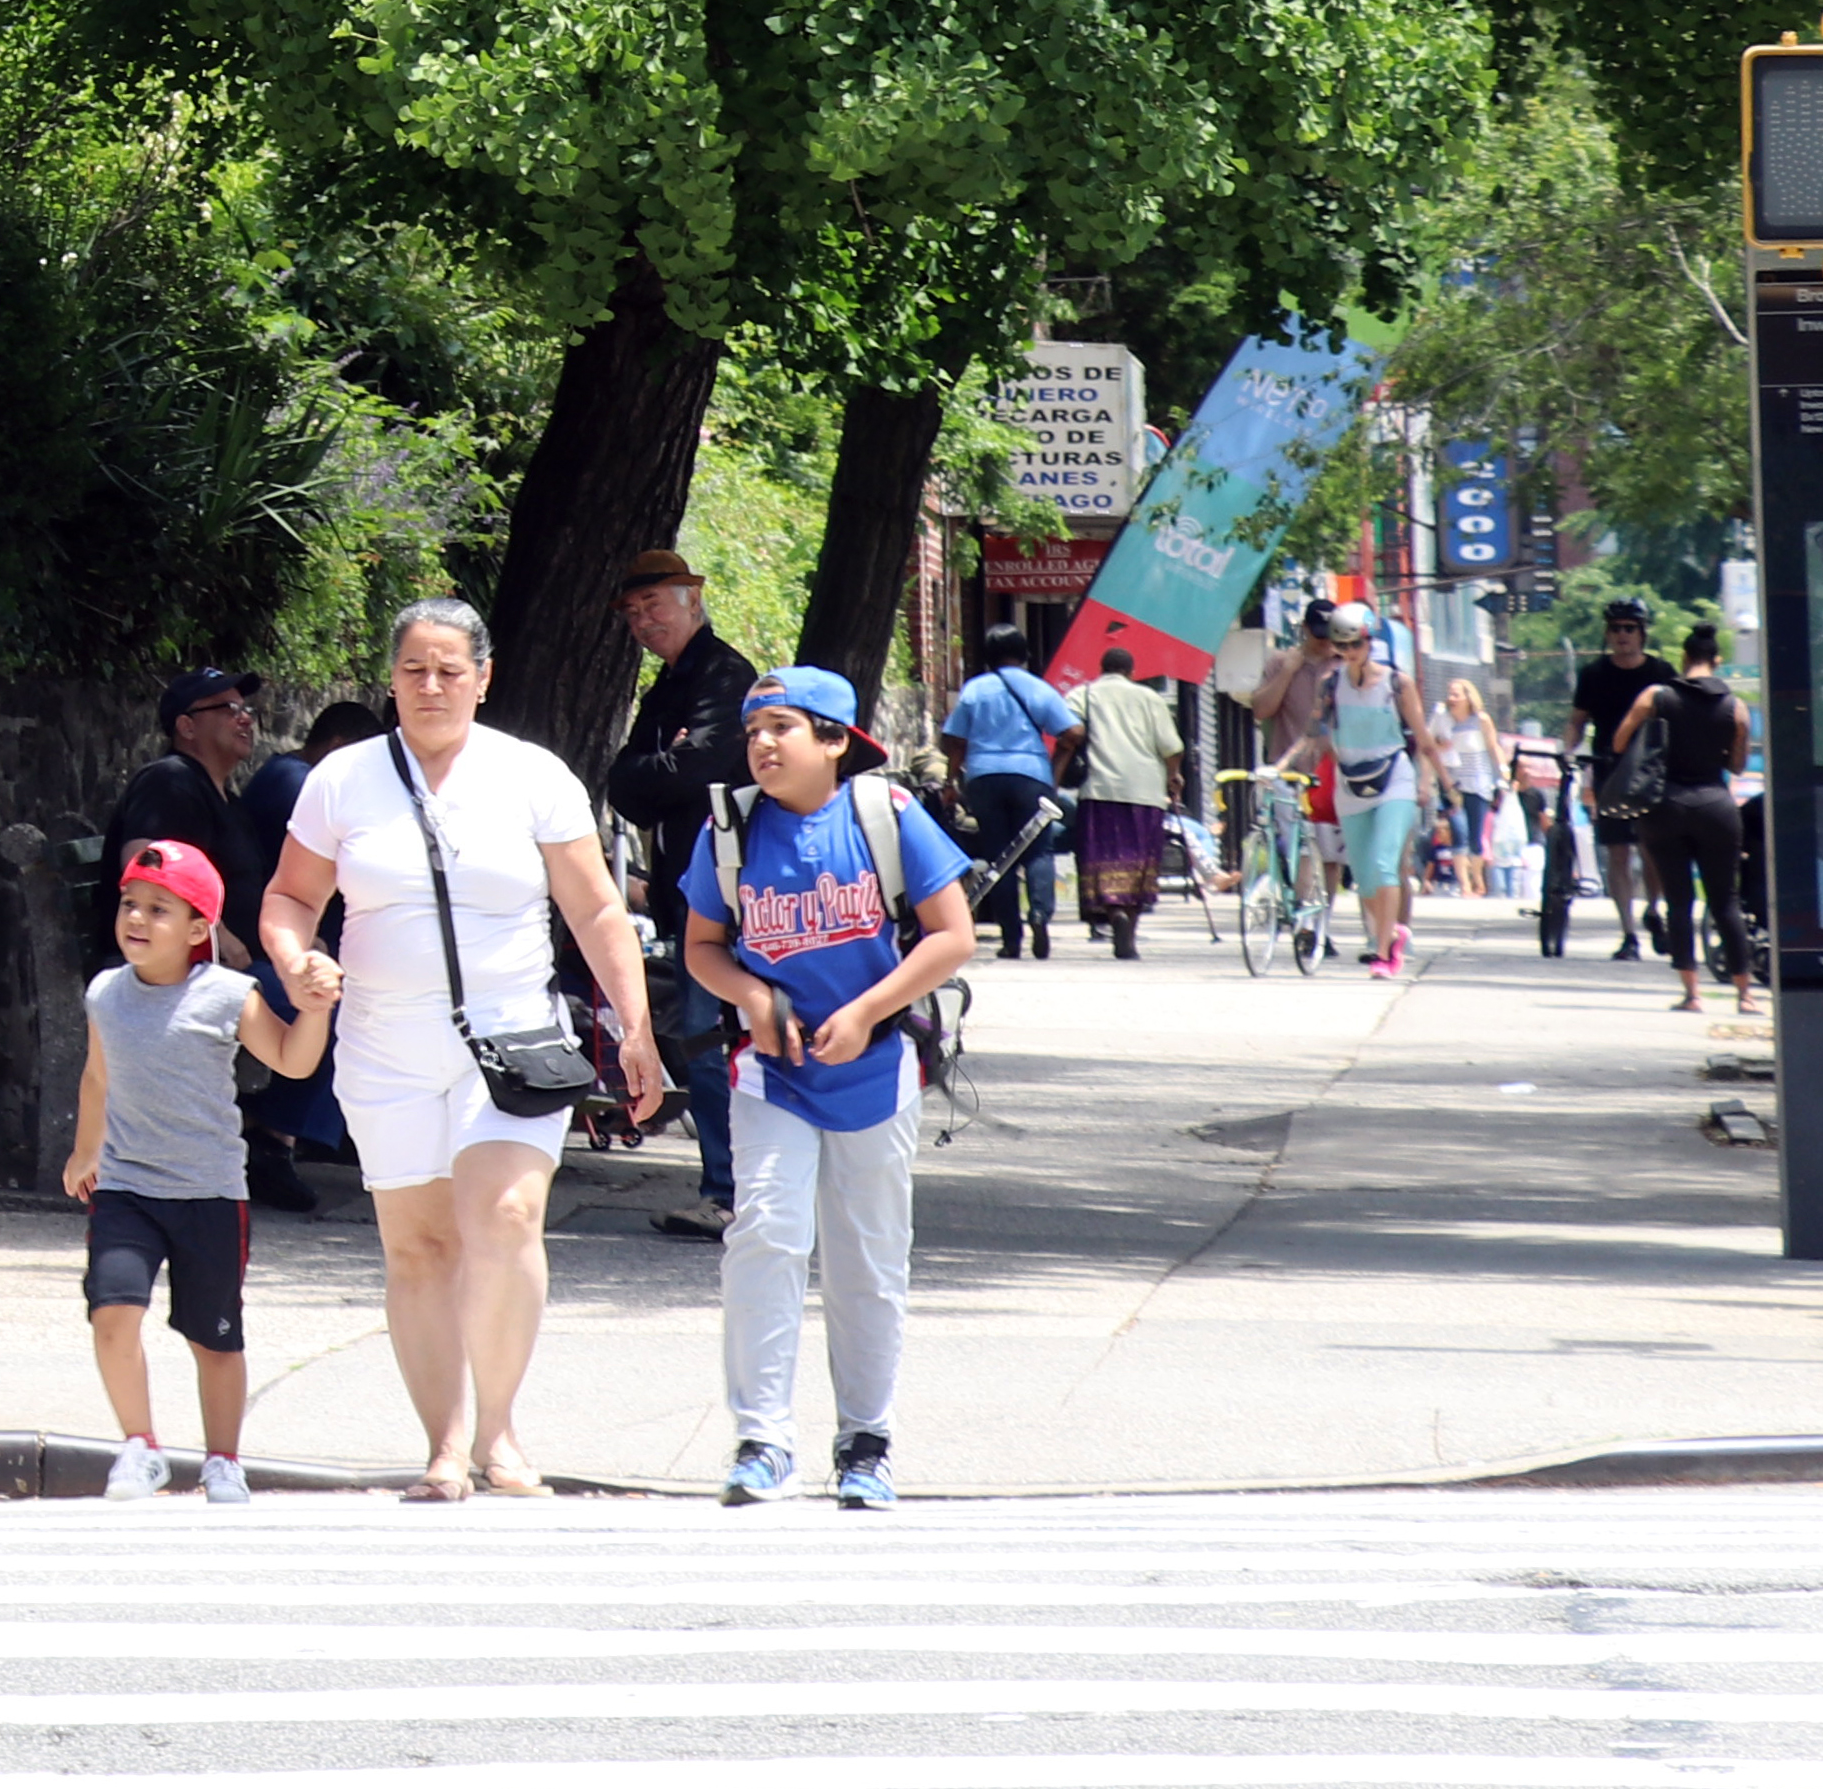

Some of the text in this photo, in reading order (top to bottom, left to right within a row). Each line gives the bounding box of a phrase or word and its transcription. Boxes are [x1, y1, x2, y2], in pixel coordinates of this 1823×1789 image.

[1084, 367, 1122, 381] DE
[1067, 430, 1106, 445] DE
[1046, 544, 1071, 556] IRS
[985, 560, 1068, 572] ENROLLED
[986, 577, 1015, 588] TAX
